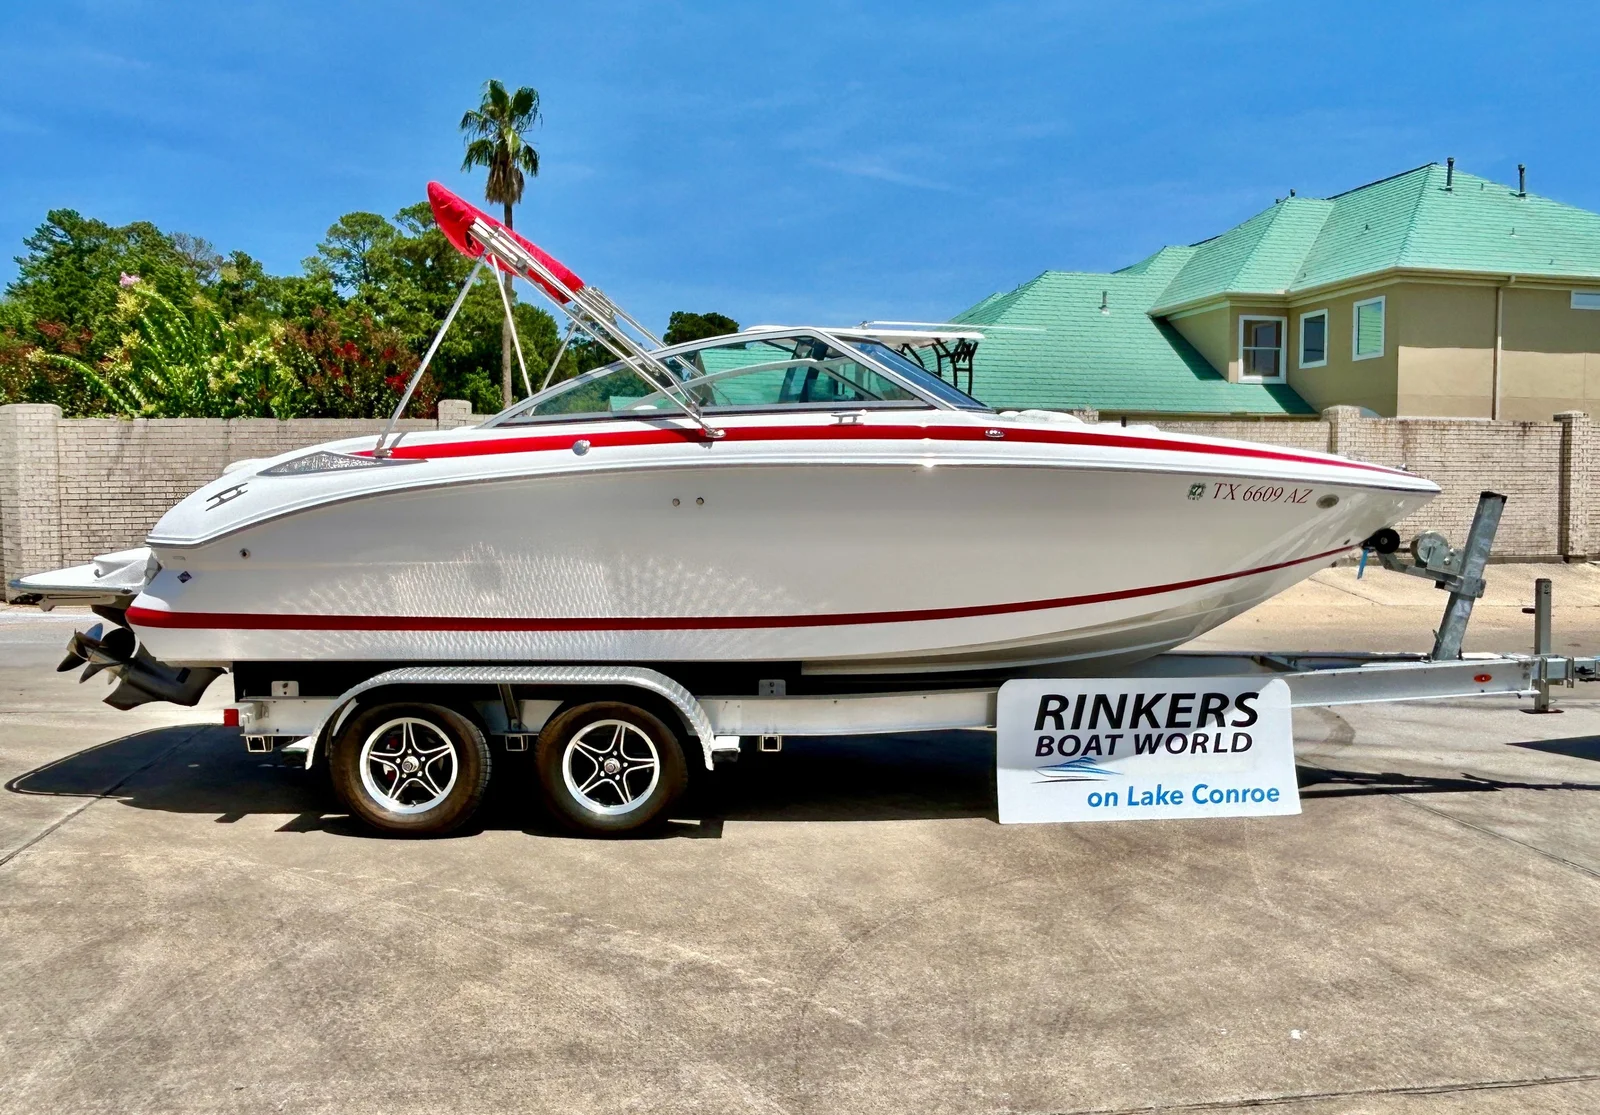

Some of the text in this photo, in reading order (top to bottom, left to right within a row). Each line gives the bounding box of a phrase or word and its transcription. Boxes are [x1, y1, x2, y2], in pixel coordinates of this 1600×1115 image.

[1213, 483, 1241, 500] TX
[1242, 485, 1284, 502] 6609
[1284, 488, 1313, 504] AZ
[1034, 692, 1259, 731] RINKERS
[1034, 732, 1253, 757] BOAT WORLD
[1087, 784, 1280, 807] on Lake Conroe
